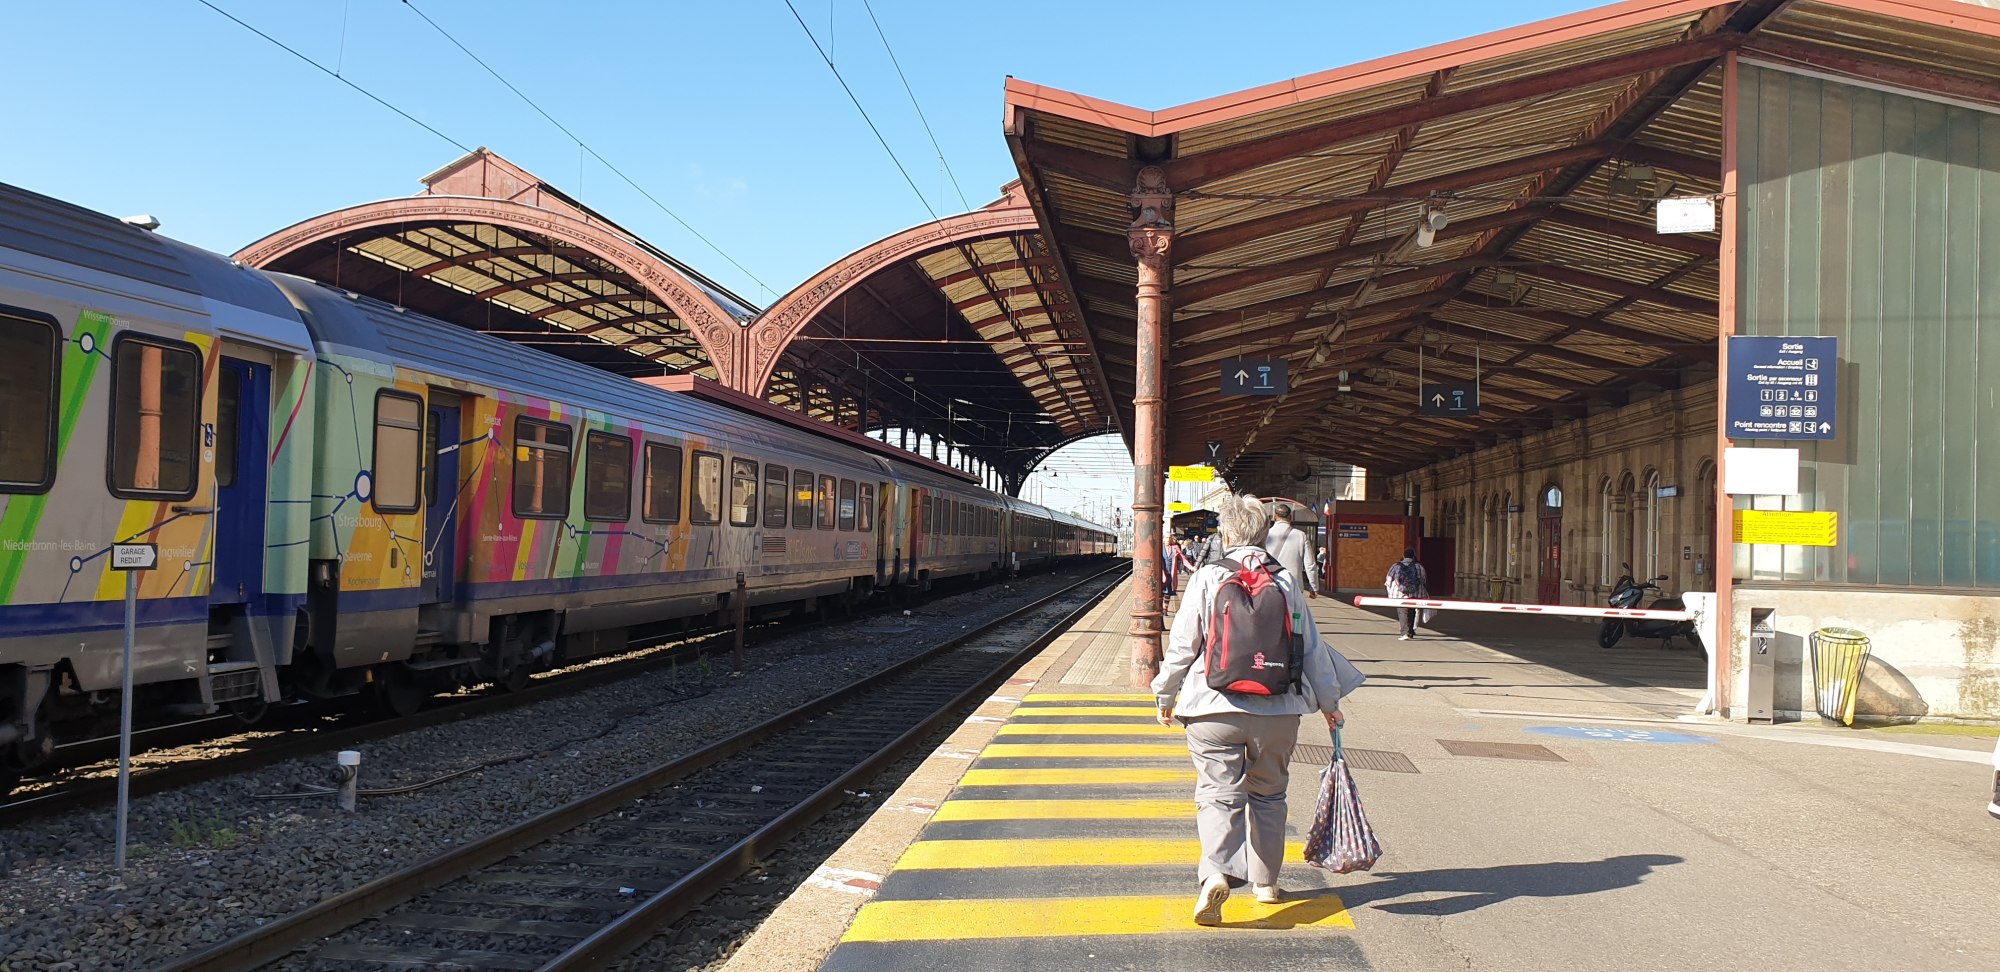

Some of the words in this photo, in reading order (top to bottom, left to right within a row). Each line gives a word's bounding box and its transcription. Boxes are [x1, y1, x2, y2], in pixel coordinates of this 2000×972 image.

[83, 308, 130, 328] Wissembourg
[1777, 358, 1803, 366] Accueil
[1260, 372, 1268, 386] 1
[1454, 396, 1461, 408] 1
[1208, 444, 1220, 457] Y
[338, 512, 383, 531] Strasbourg
[3, 538, 97, 552] Niederbronn-les-Bains
[345, 550, 373, 562] Saverne
